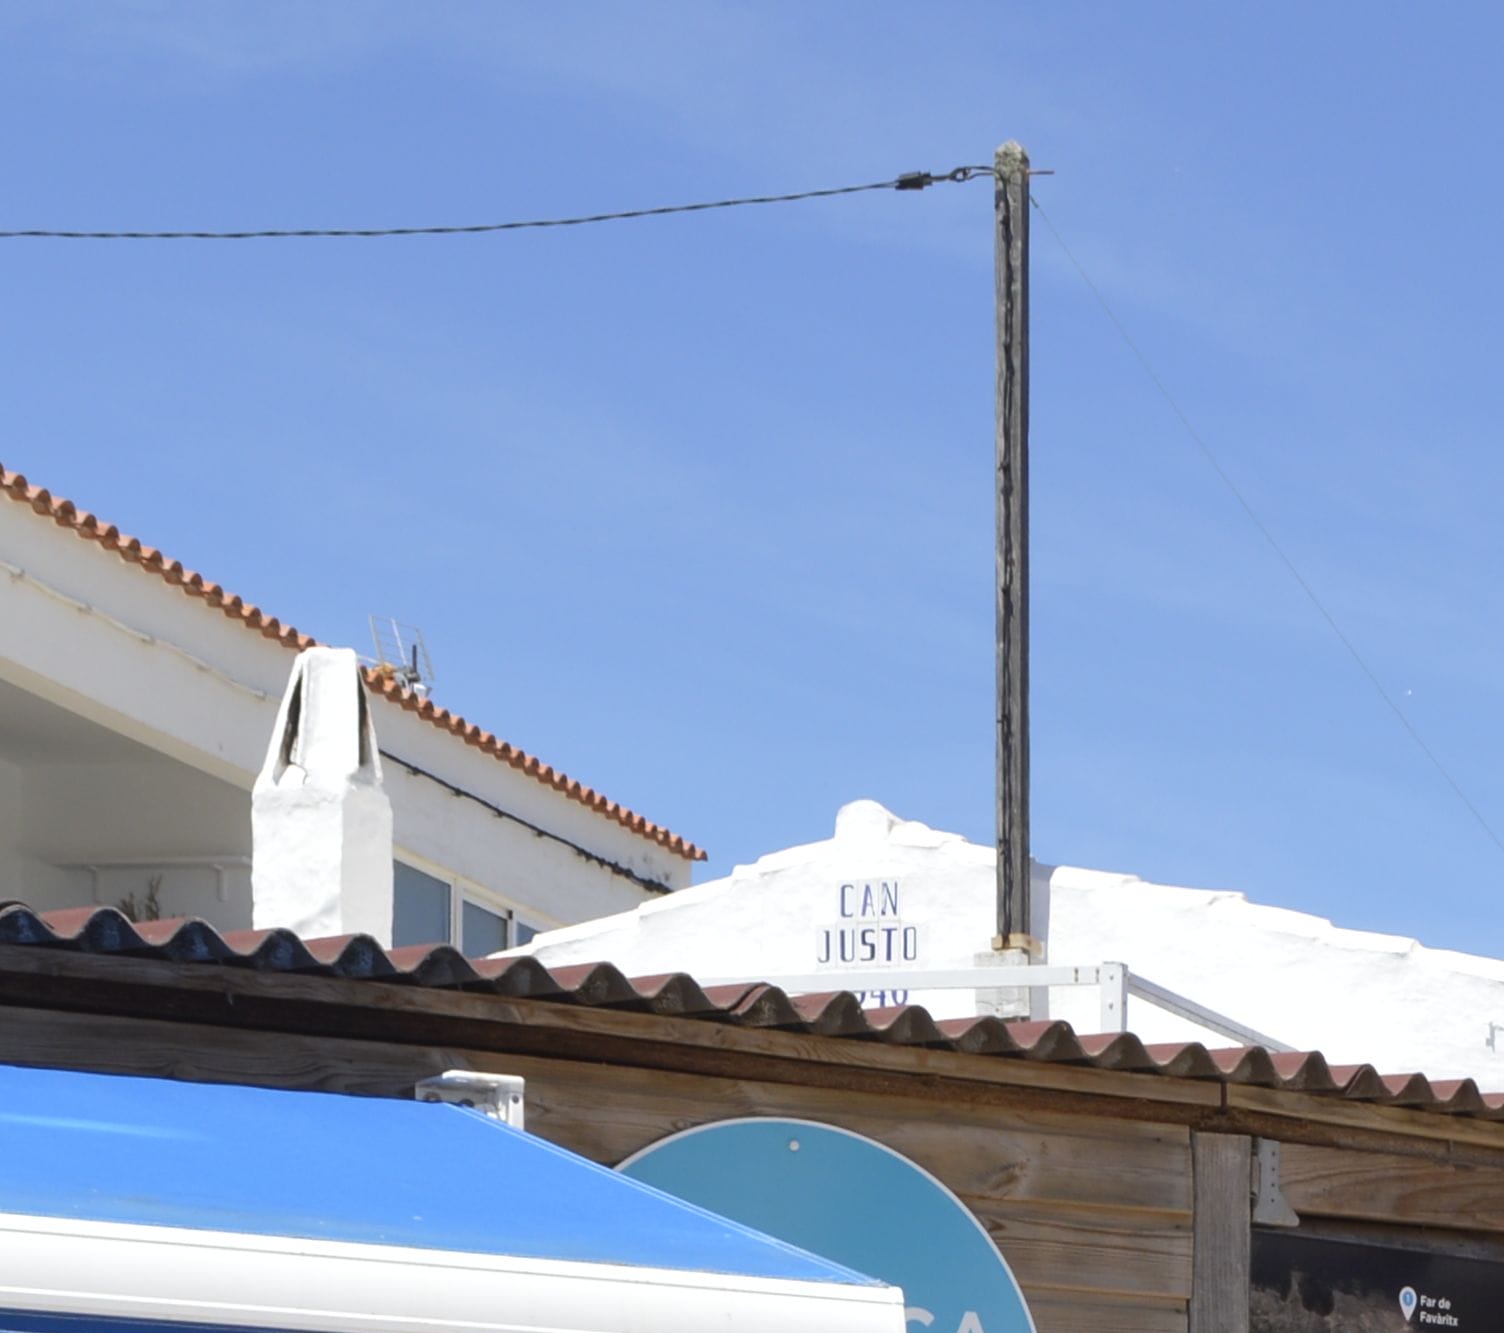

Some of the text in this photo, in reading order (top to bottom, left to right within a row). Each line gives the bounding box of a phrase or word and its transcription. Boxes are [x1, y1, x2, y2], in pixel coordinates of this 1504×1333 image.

[840, 881, 898, 918] CAN
[818, 926, 917, 963] JUSTO
[1420, 1295, 1452, 1310] Far de
